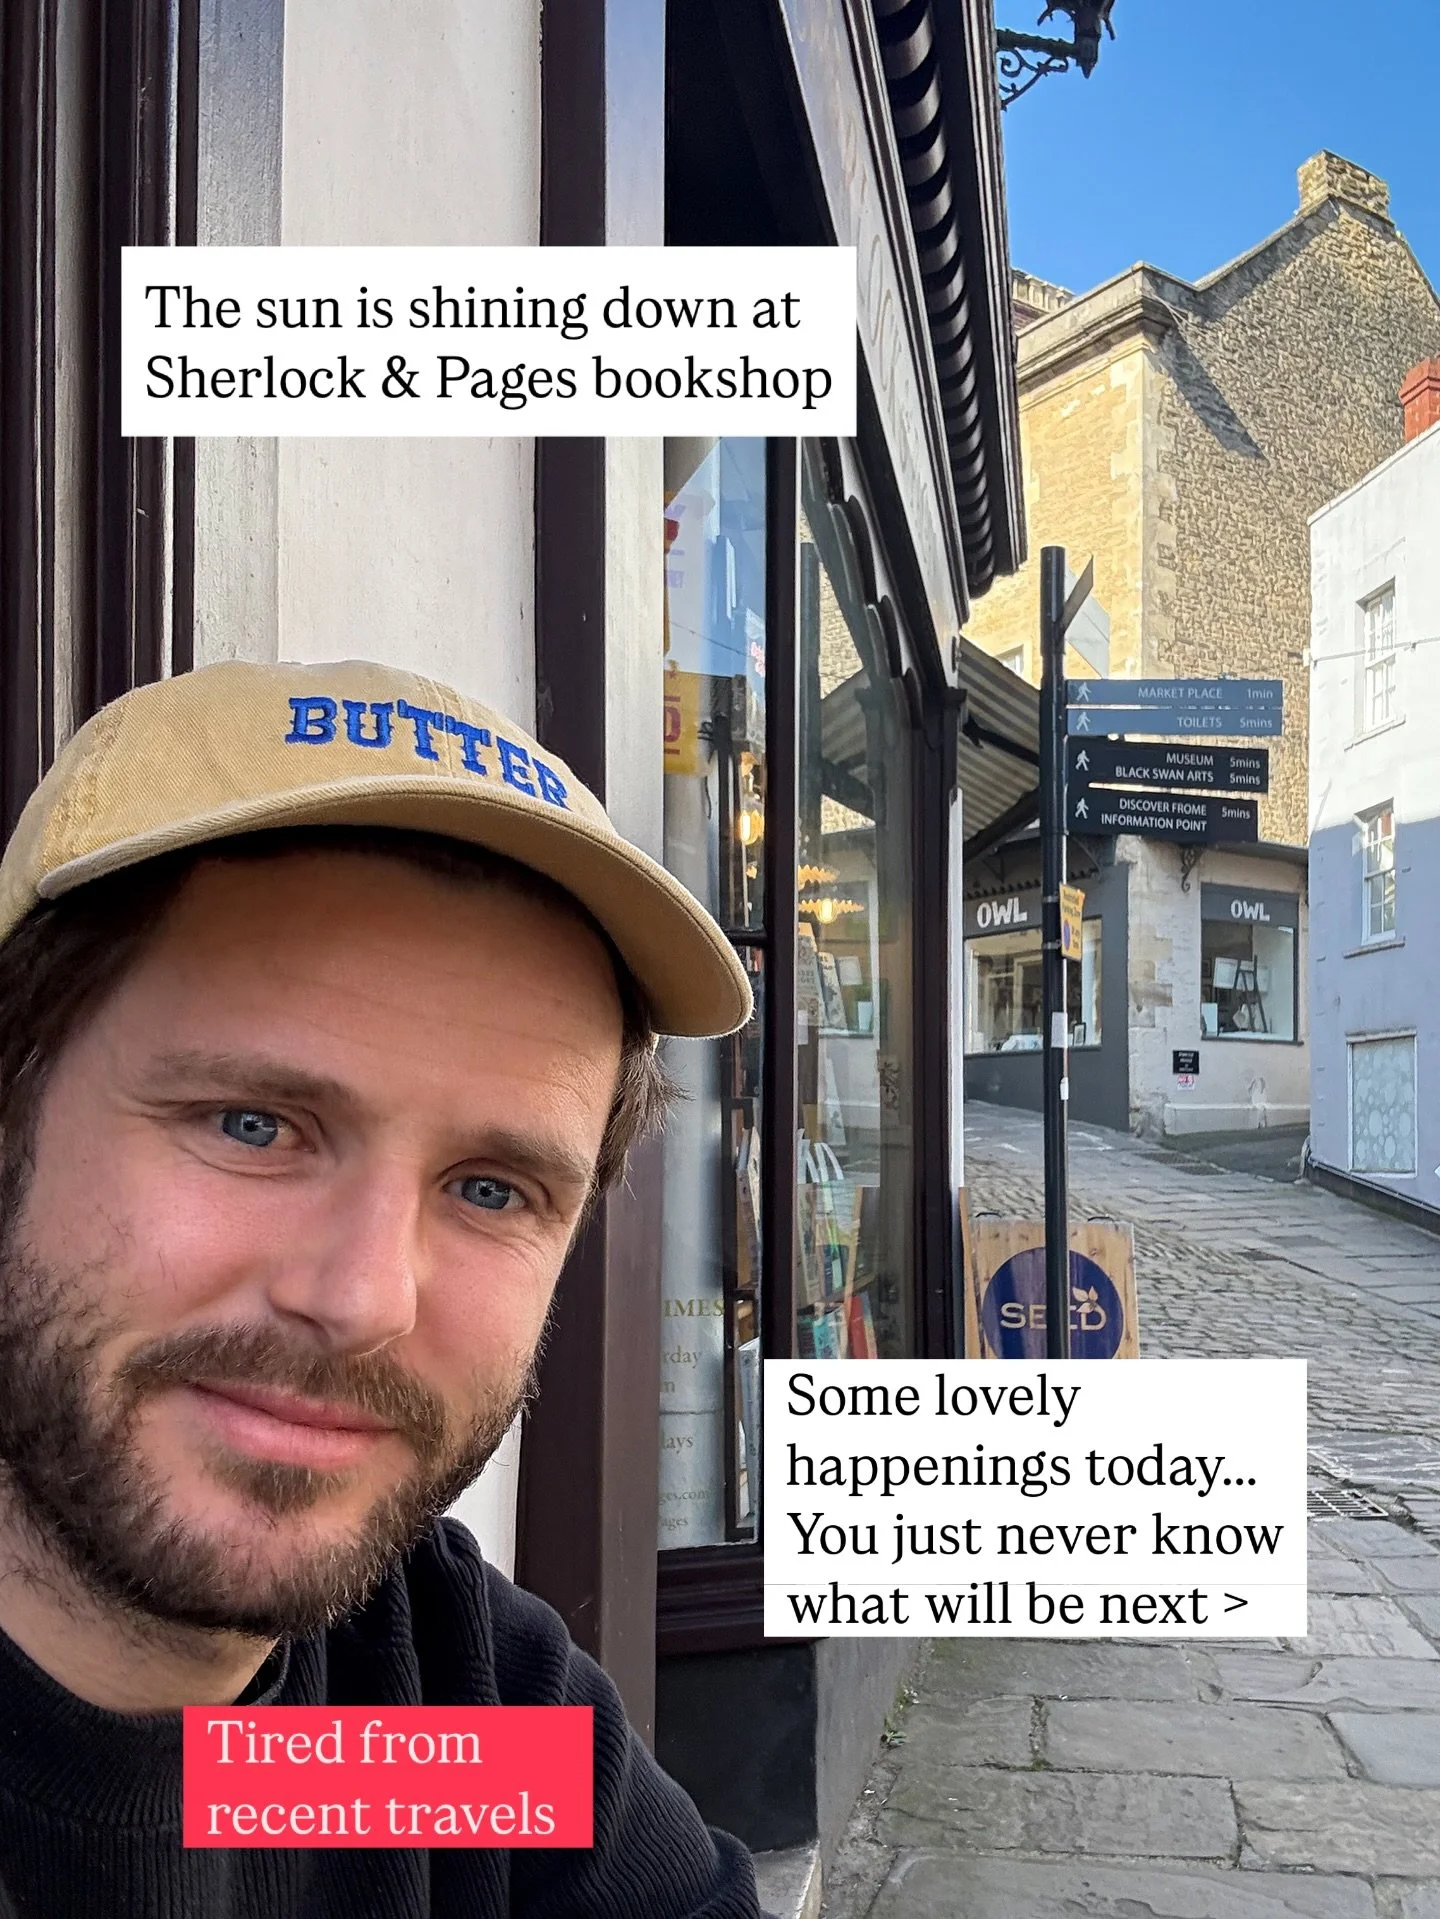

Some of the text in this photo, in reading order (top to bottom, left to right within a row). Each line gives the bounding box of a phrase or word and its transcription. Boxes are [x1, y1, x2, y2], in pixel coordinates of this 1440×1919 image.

[1138, 687, 1273, 699] MARKET PLACE 1min
[1177, 716, 1272, 729] TOILETS 5mins
[284, 696, 573, 812] BUTTER
[1166, 753, 1261, 769] MUSEUM 5mins
[1115, 766, 1261, 785] BLACK SWAN ARTS 5mins
[1119, 798, 1251, 819] DISCOVER FROME 5mins
[1101, 813, 1208, 832] INFORMATION POINT
[976, 896, 1028, 928] OWL
[1230, 899, 1270, 922] OWL
